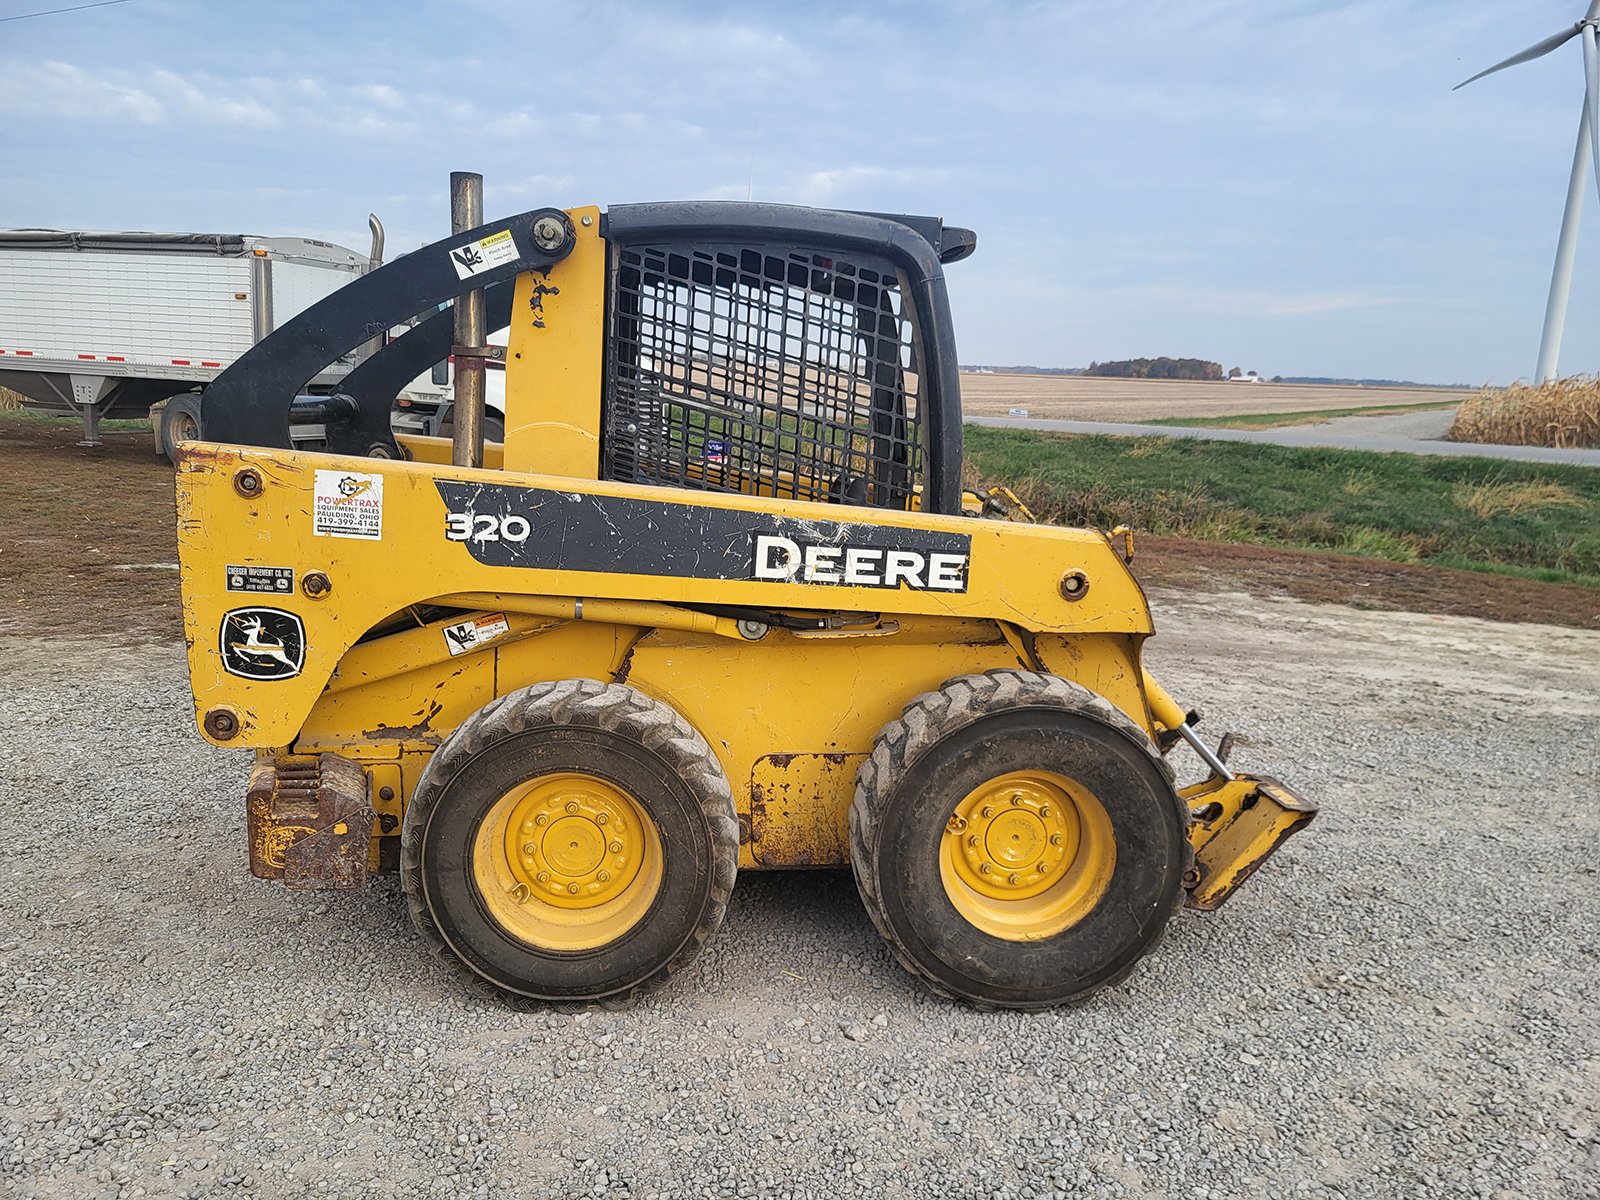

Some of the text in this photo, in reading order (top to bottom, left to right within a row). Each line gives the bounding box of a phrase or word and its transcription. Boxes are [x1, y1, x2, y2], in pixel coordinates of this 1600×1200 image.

[317, 511, 380, 521] PAULDING, OHIO
[317, 517, 379, 527] 419-399-4144
[446, 512, 531, 543] 320
[755, 535, 966, 589] DEERE
